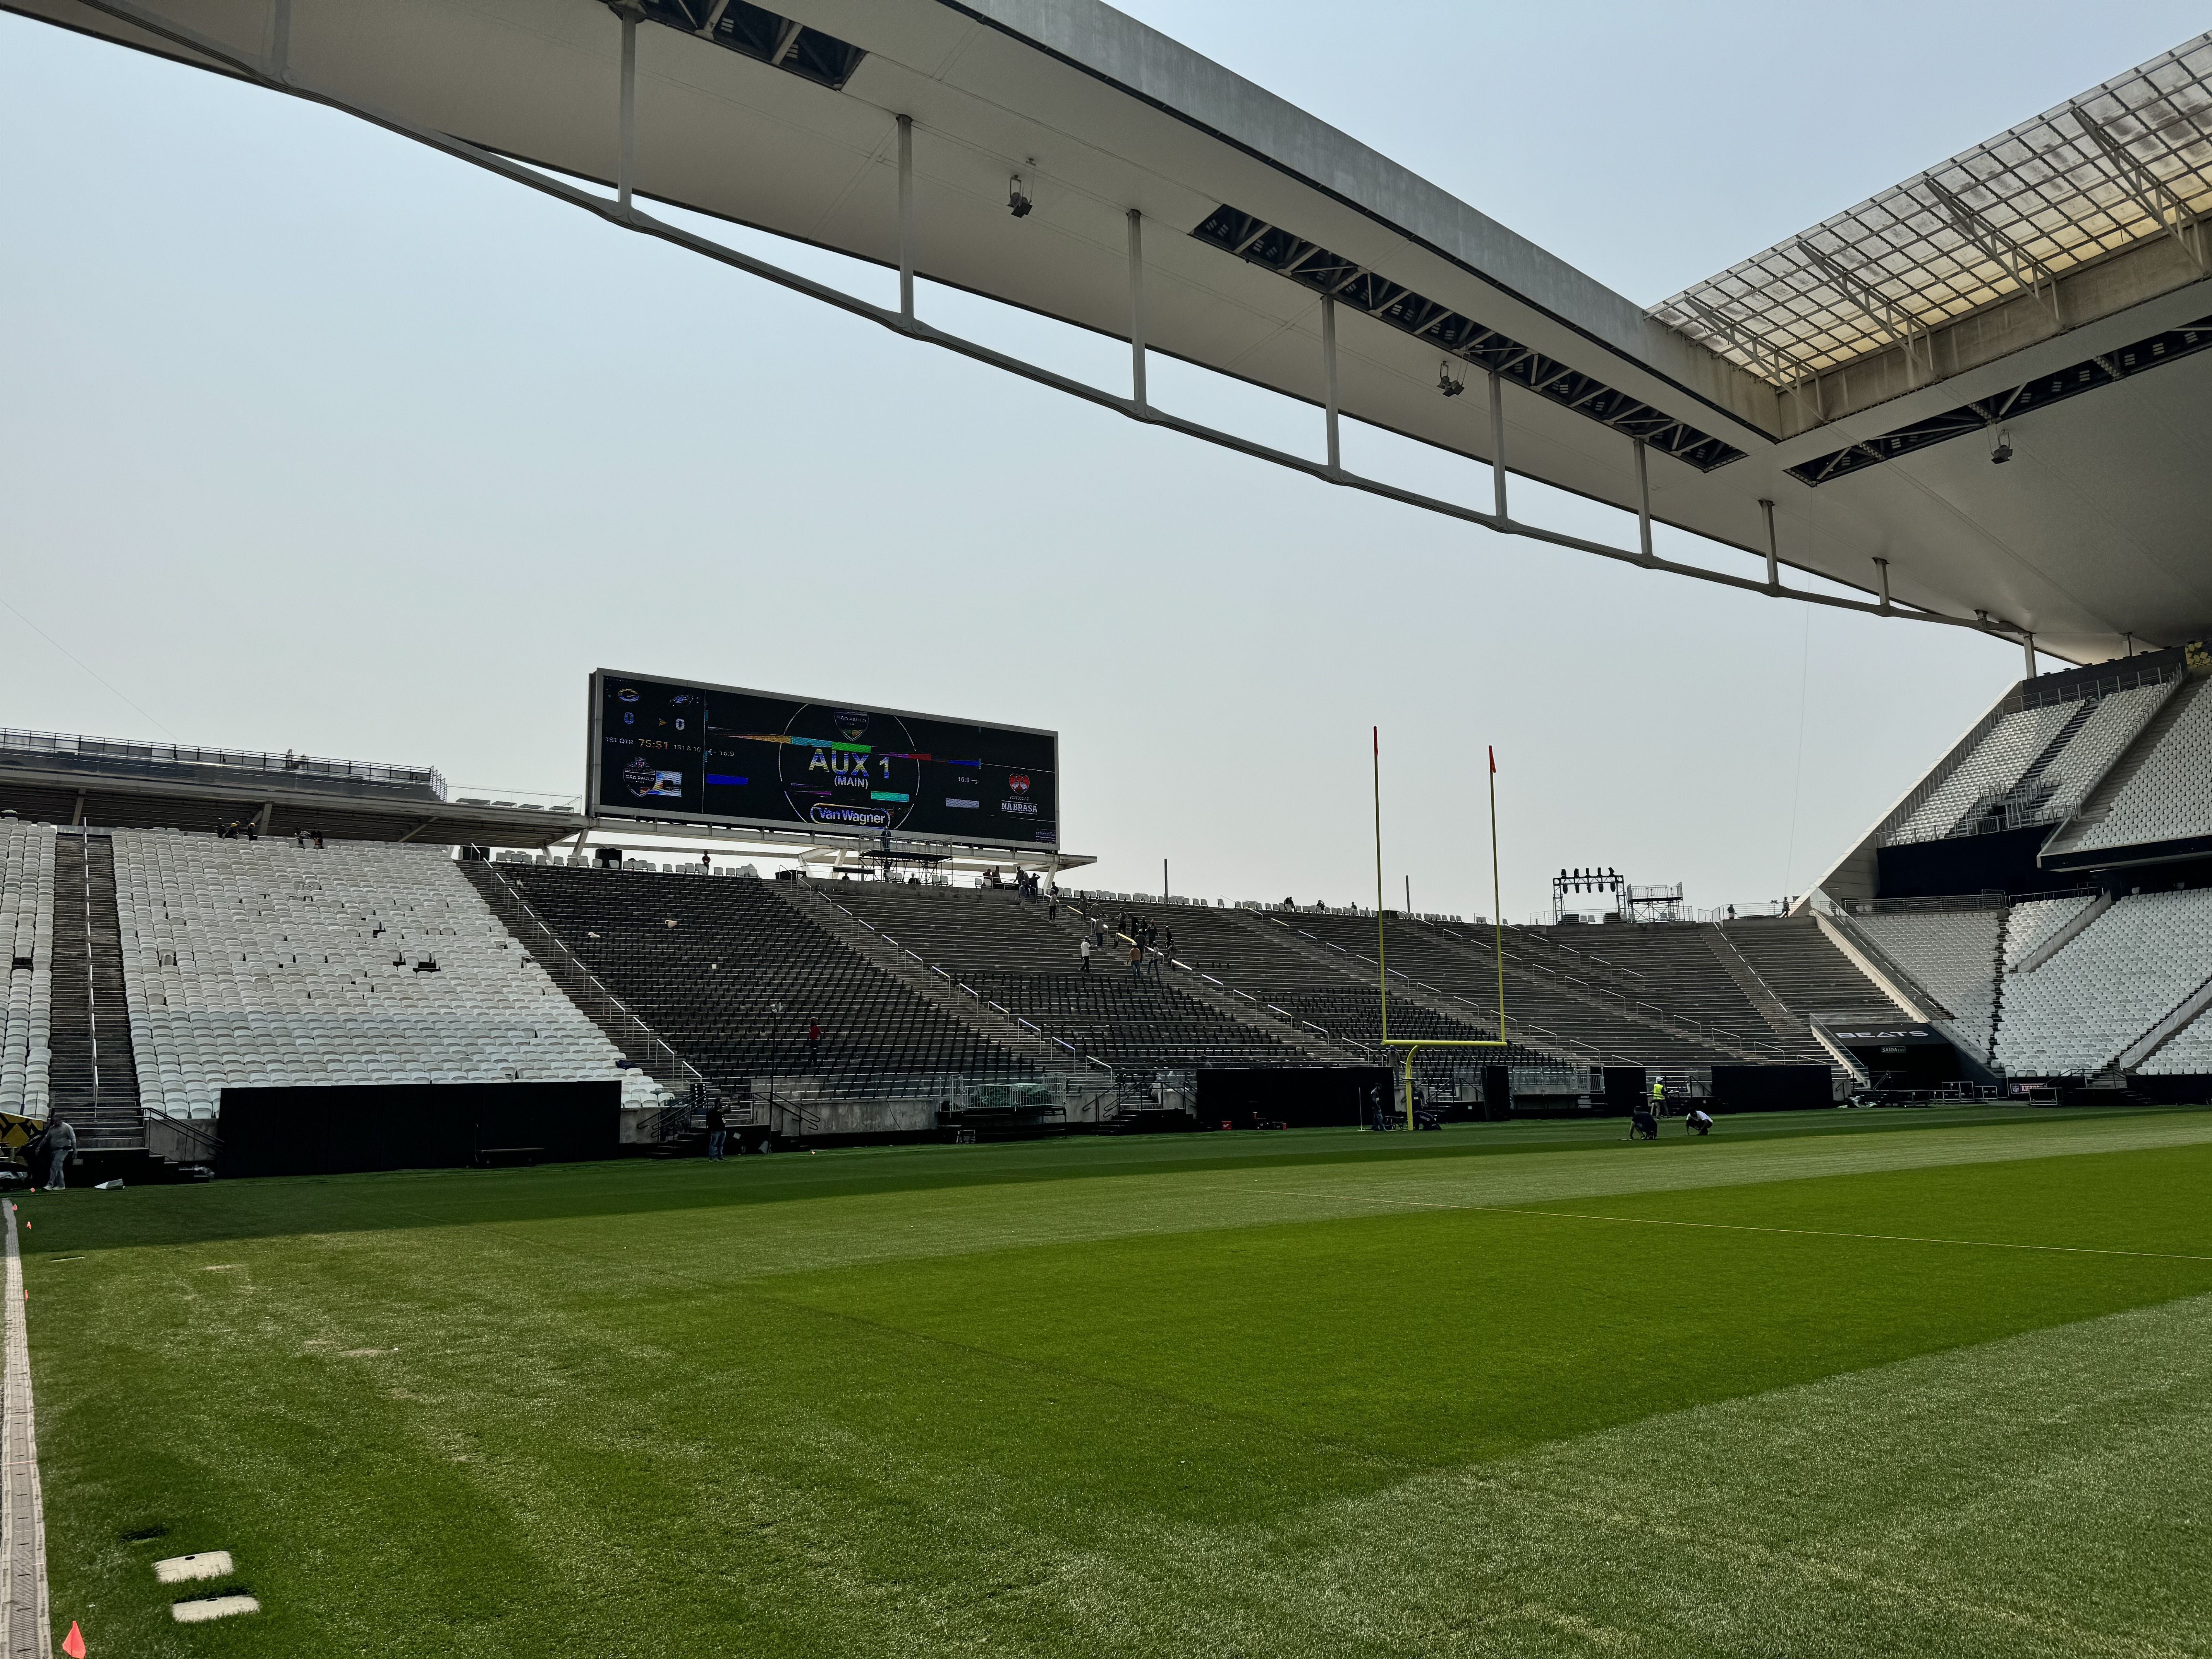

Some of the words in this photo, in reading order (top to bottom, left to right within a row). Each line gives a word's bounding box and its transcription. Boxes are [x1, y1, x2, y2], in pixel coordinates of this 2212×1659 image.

[624, 712, 634, 724] 0
[675, 718, 685, 730] 0
[808, 749, 869, 777] AUX
[879, 756, 889, 779] 1
[834, 776, 868, 790] (MAIN)
[1013, 803, 1038, 813] BRASA
[819, 808, 840, 819] Van
[842, 809, 886, 825] Wagner
